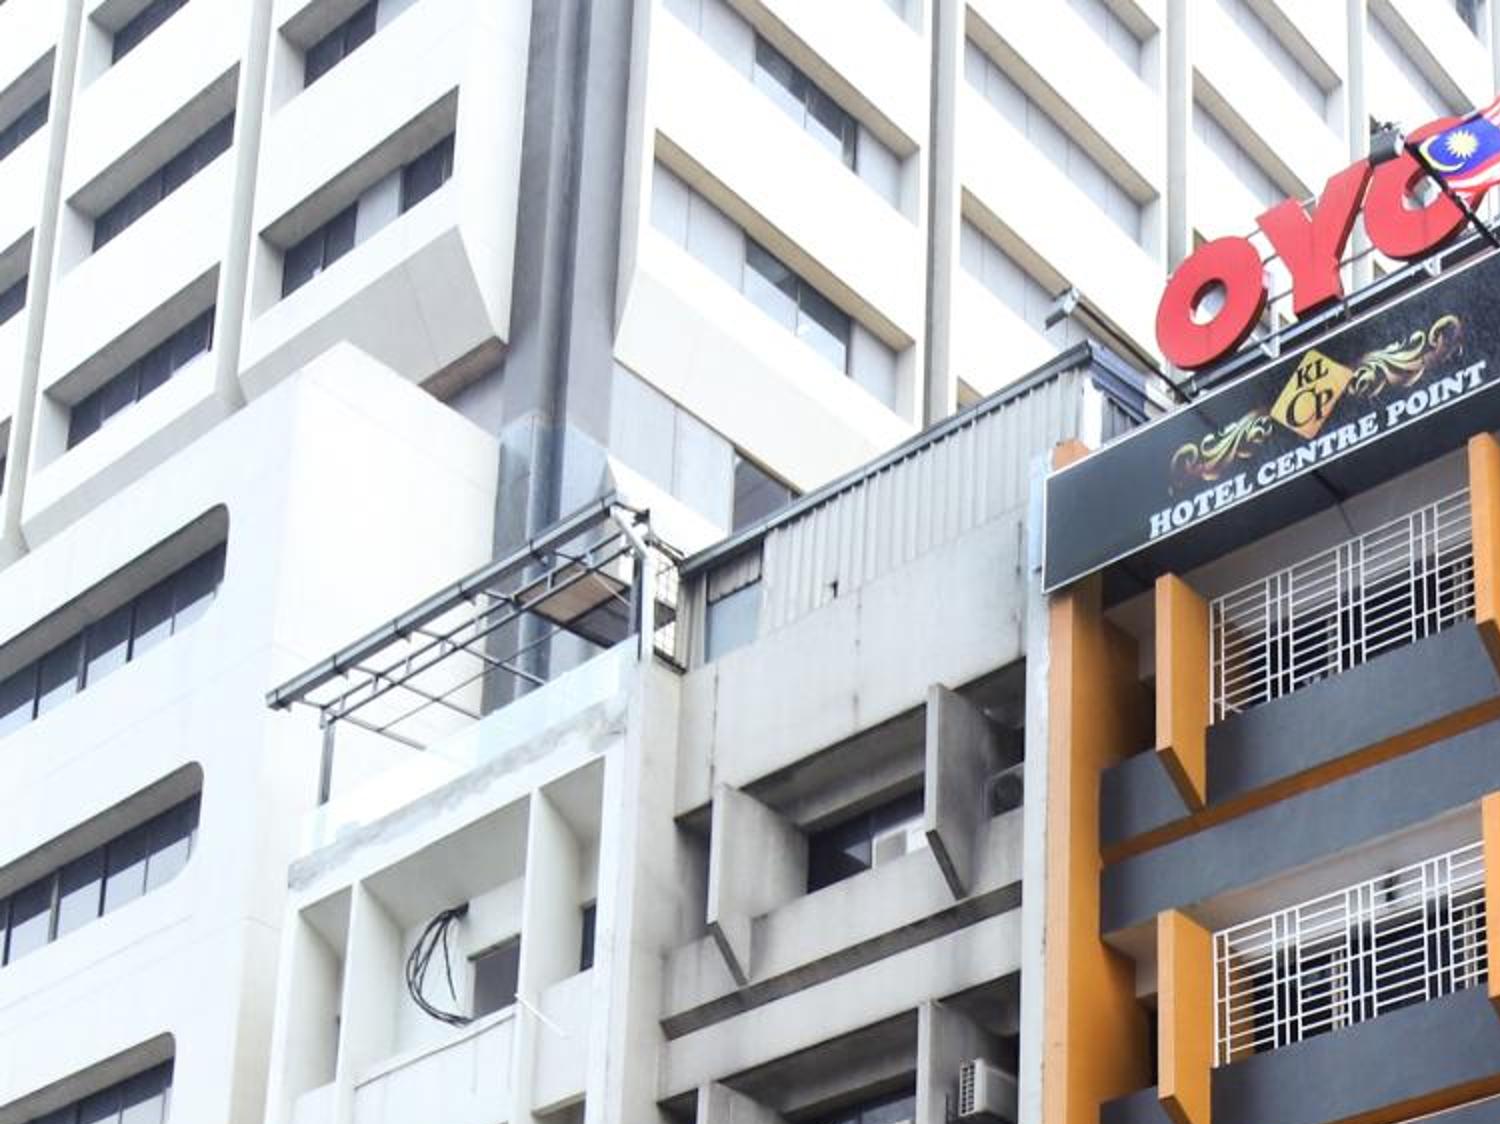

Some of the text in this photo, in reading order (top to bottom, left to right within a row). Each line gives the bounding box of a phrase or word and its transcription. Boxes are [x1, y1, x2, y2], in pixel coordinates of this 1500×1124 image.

[1155, 116, 1492, 370] OYO
[1286, 387, 1334, 429] CP
[1297, 358, 1329, 388] KL
[1149, 360, 1487, 540] HOTEL CENTRE POINT
